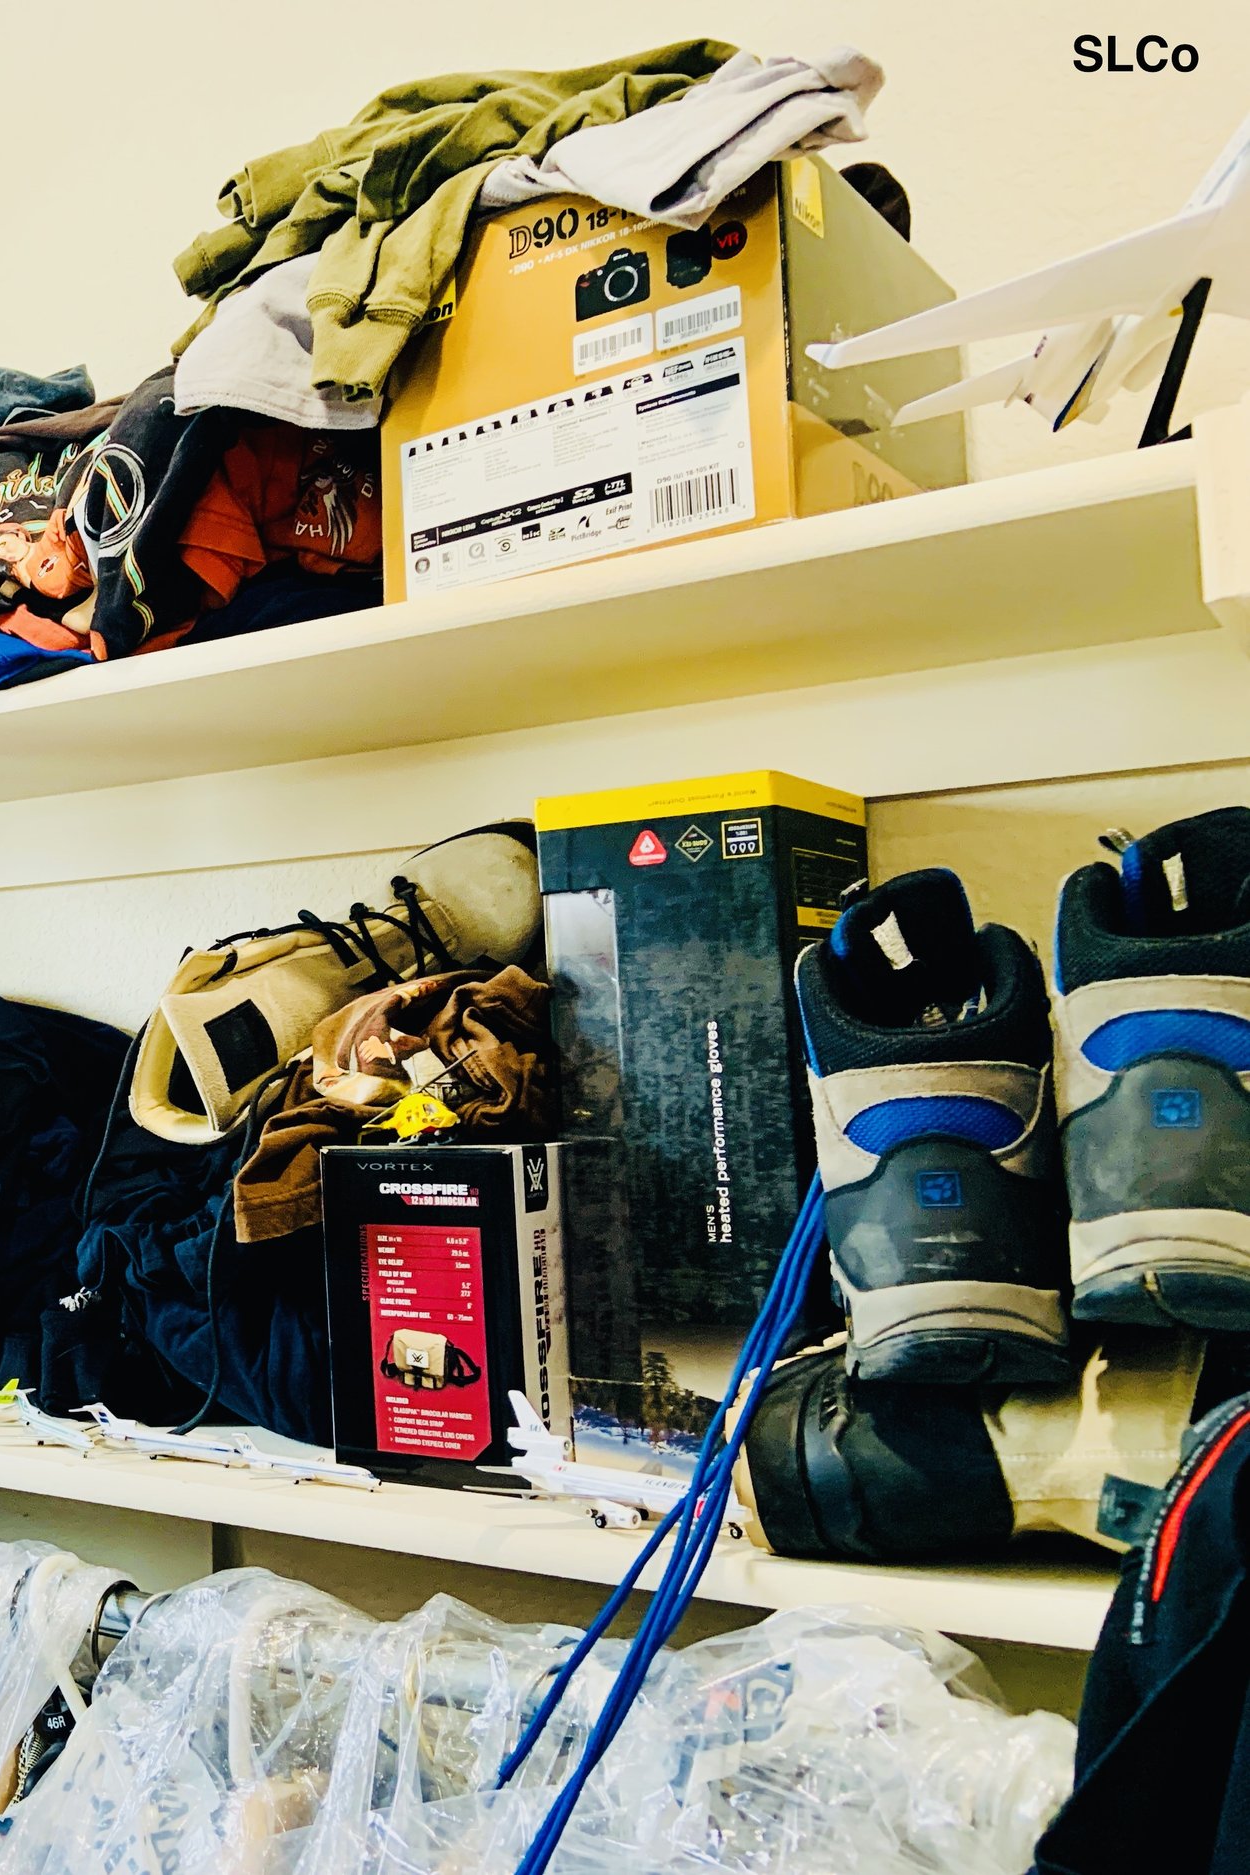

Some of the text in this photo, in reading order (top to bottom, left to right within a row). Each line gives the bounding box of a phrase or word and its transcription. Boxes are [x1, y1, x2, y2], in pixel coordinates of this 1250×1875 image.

[509, 207, 580, 260] D90
[716, 231, 740, 250] VR
[543, 249, 563, 264] AF-S
[565, 246, 579, 260] DX
[580, 232, 616, 255] NIKKOR
[656, 475, 672, 485] D90
[709, 462, 719, 471] KIT
[605, 502, 633, 516] Exif Print
[571, 529, 602, 543] PictBridge
[706, 1020, 733, 1244] heated performance gloves
[356, 1161, 434, 1172] VORTEX
[379, 1182, 469, 1196] CROSSFIRE
[411, 1195, 478, 1207] 12x50 BINOCULAR
[705, 1203, 717, 1243] MEN'S
[358, 1223, 370, 1301] SPECIFICATIONS
[380, 1297, 395, 1305] CLOSE
[420, 1408, 448, 1418] BINOCULAR
[393, 1416, 415, 1425] COMFORT
[415, 1418, 429, 1426] NECK
[442, 1431, 455, 1439] LENS
[46, 1715, 66, 1730] 46R
